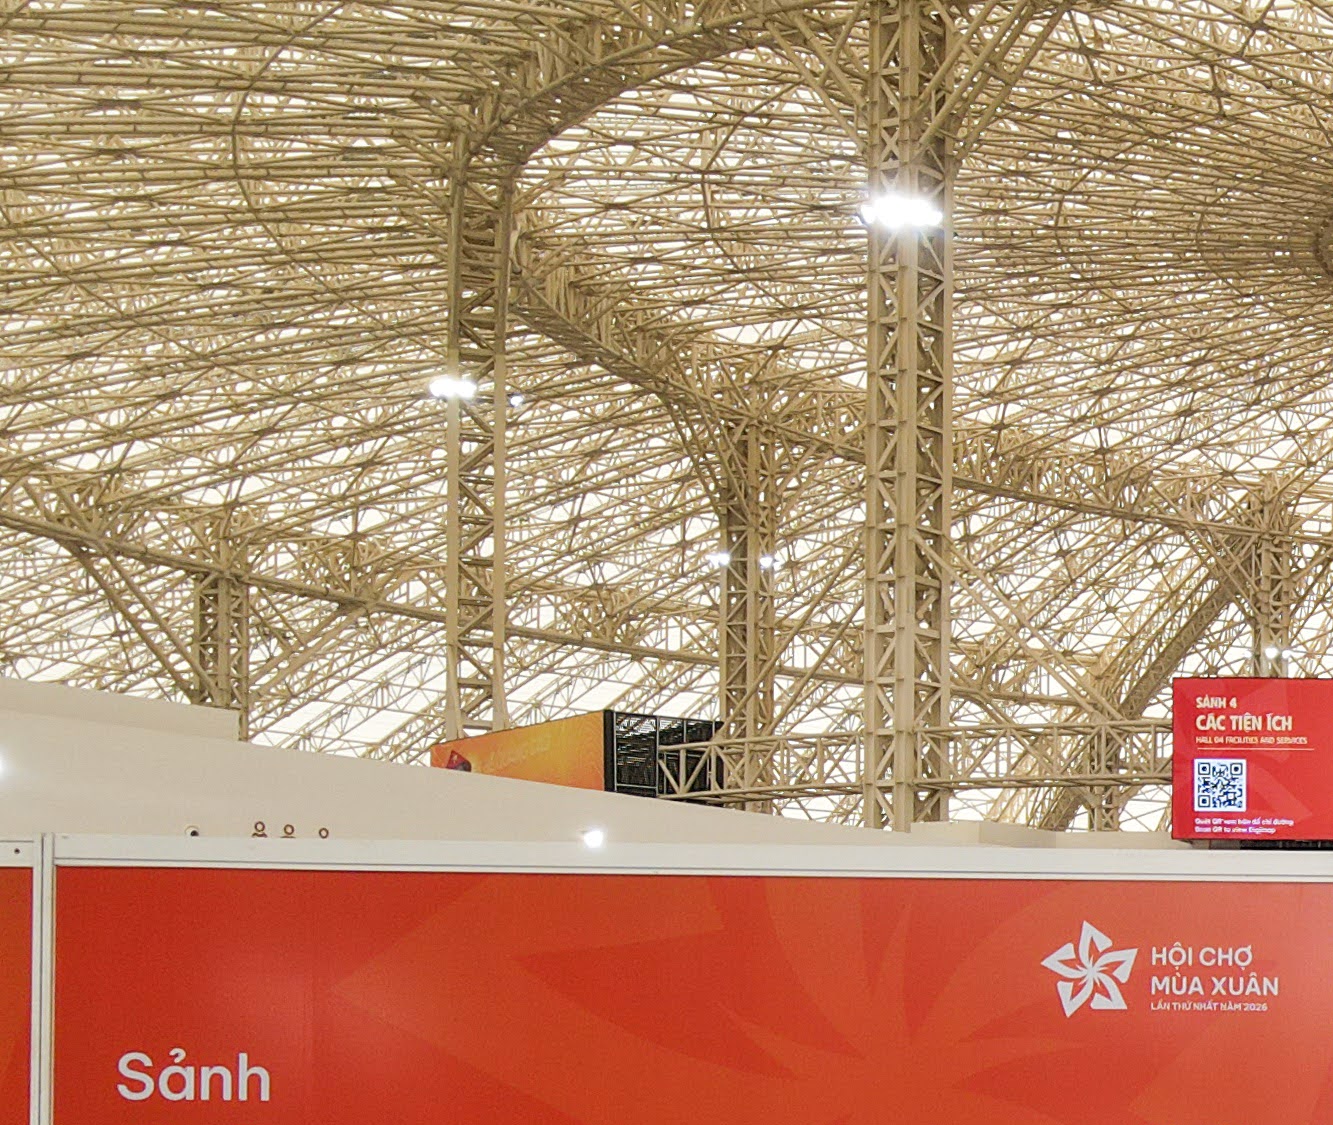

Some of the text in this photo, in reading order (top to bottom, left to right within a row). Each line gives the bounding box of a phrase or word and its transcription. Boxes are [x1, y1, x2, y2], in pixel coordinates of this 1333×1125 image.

[1229, 699, 1238, 709] 4
[1195, 712, 1293, 733] CÁC TIỆN ÍCH
[1151, 942, 1253, 972] HỘI CHỢ
[1150, 969, 1279, 997] MÙA XUÂN
[116, 1046, 271, 1102] Sảnh
